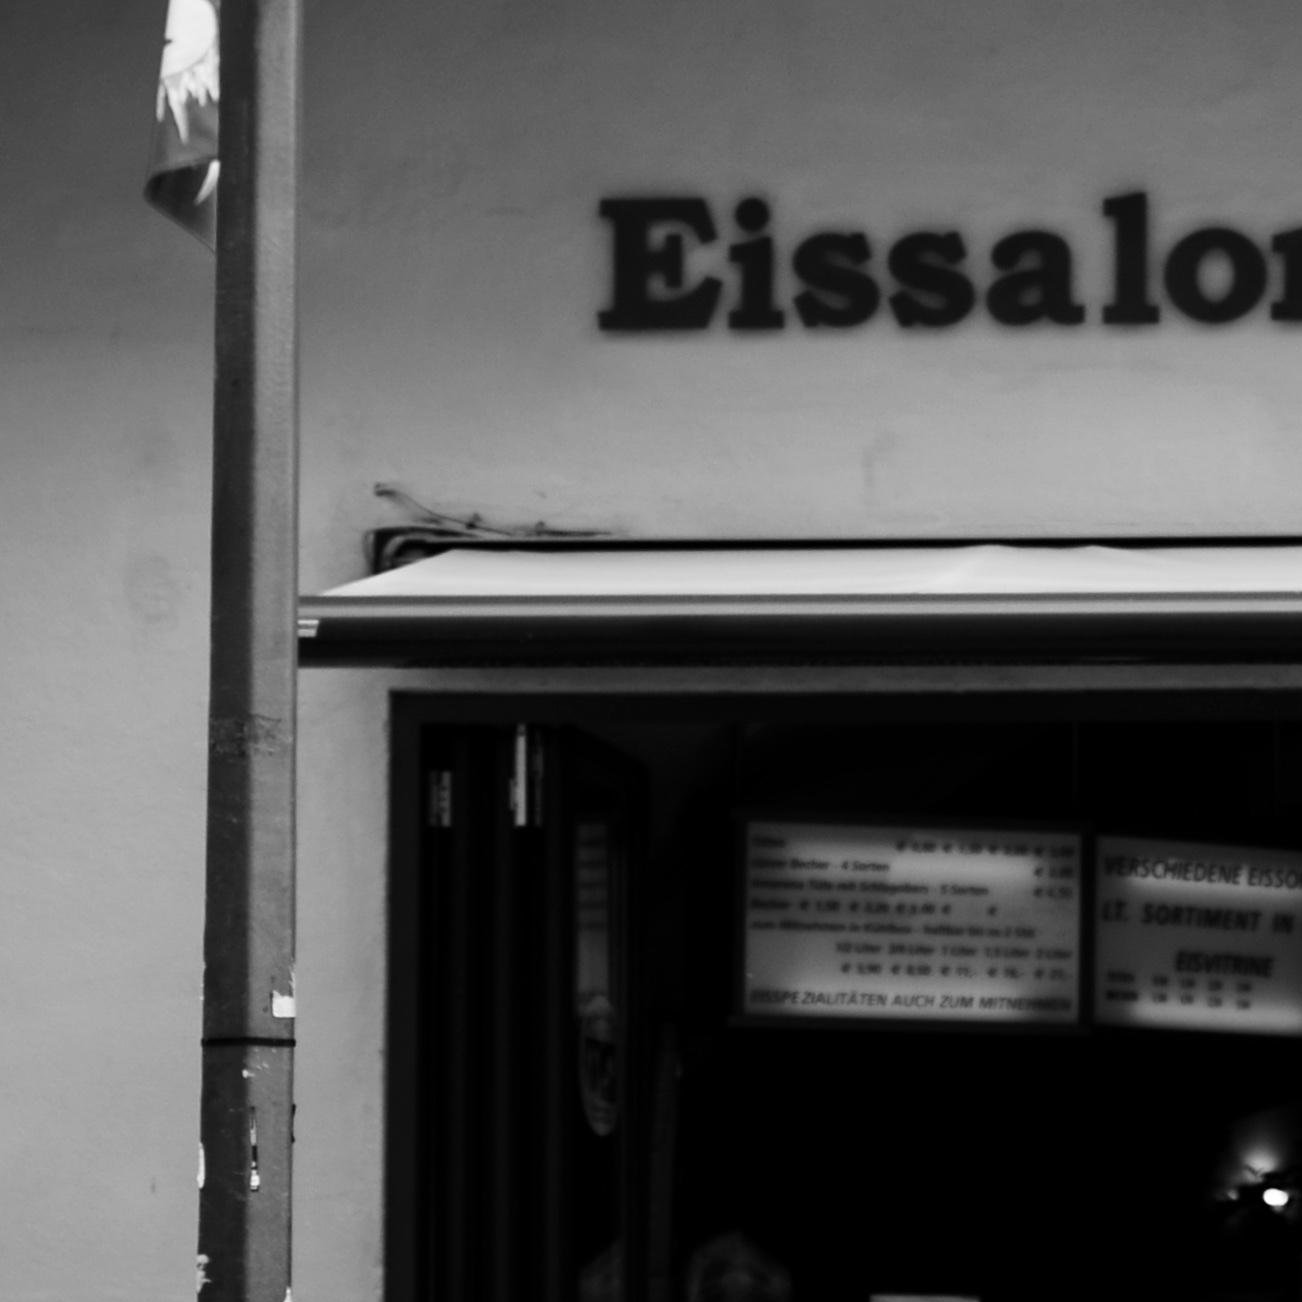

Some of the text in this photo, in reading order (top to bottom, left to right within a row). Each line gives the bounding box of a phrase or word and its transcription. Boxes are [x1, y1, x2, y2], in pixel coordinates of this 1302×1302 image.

[1103, 857, 1241, 885] VERSCHIEDENE
[1141, 903, 1262, 931] SORTIMENT
[1272, 913, 1295, 933] IN
[1175, 951, 1273, 978] EISVITRINE
[891, 994, 934, 1008] AUCH
[939, 995, 973, 1008] ZUM
